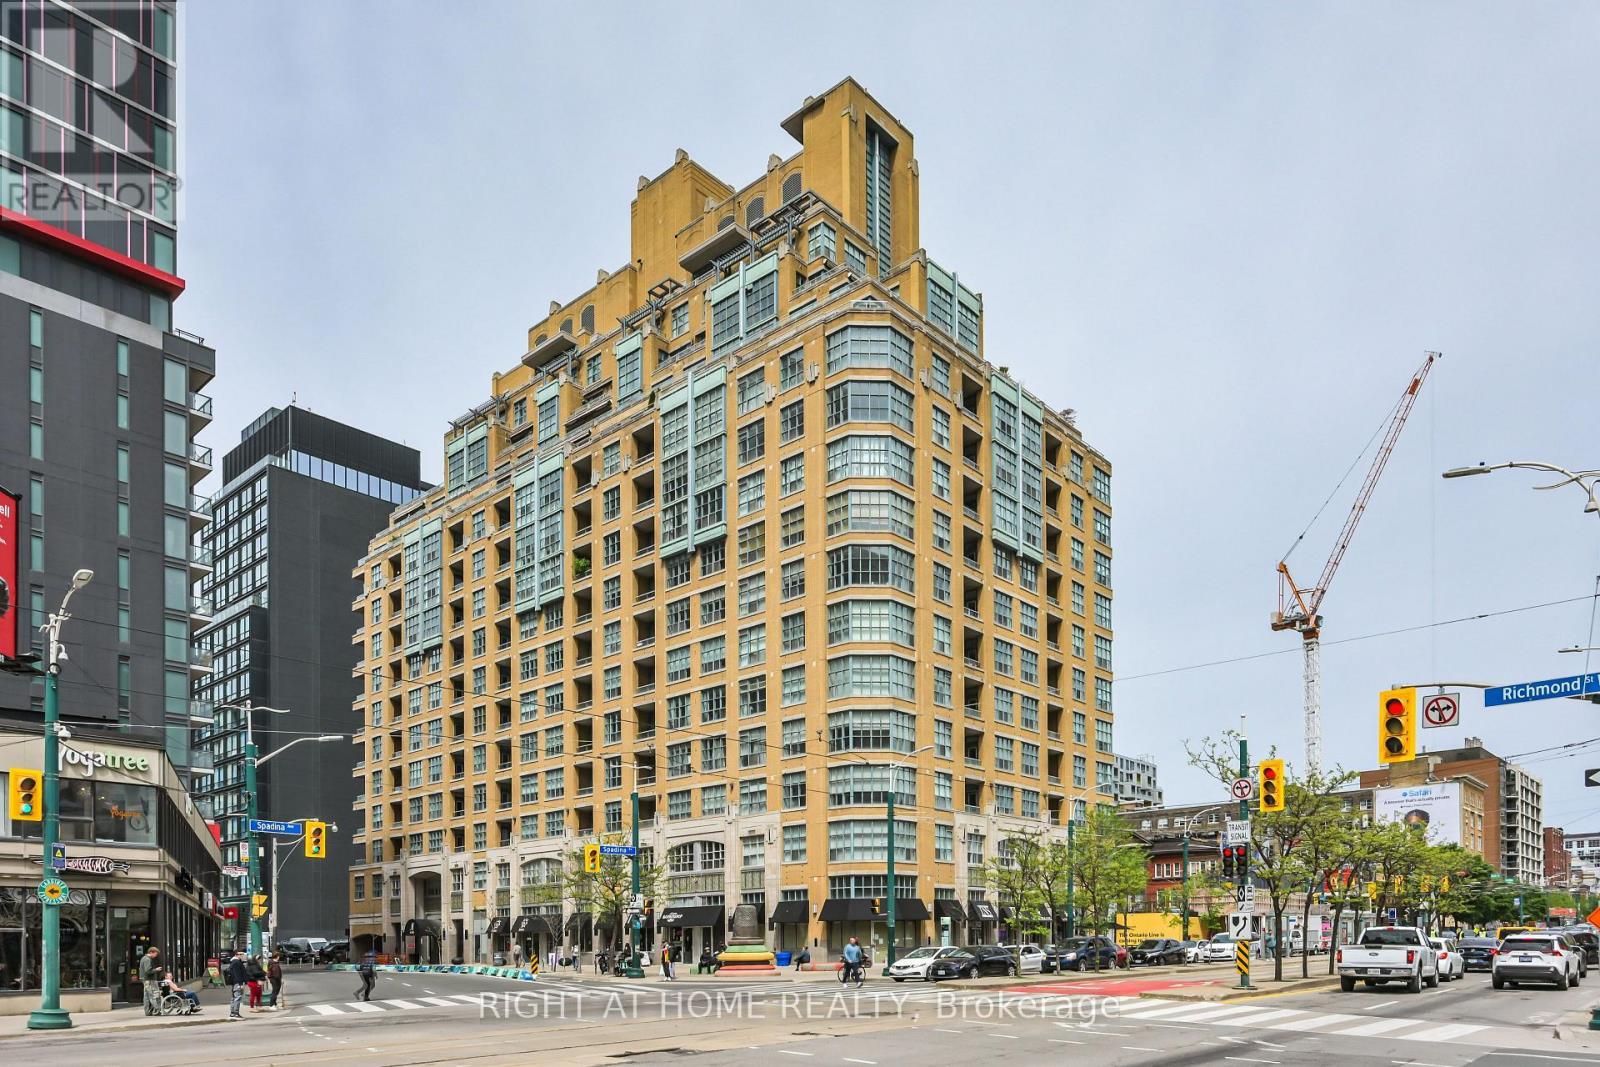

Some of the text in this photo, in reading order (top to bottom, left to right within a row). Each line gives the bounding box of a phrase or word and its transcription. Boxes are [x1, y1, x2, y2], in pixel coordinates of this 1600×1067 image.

[1502, 677, 1581, 701] Richmond
[1586, 675, 1594, 684] St
[1409, 788, 1432, 797] Safari
[257, 821, 286, 831] Spadina
[1229, 822, 1250, 831] TRANSIT
[1231, 832, 1249, 840] SIGNAL
[603, 846, 626, 854] Spadina
